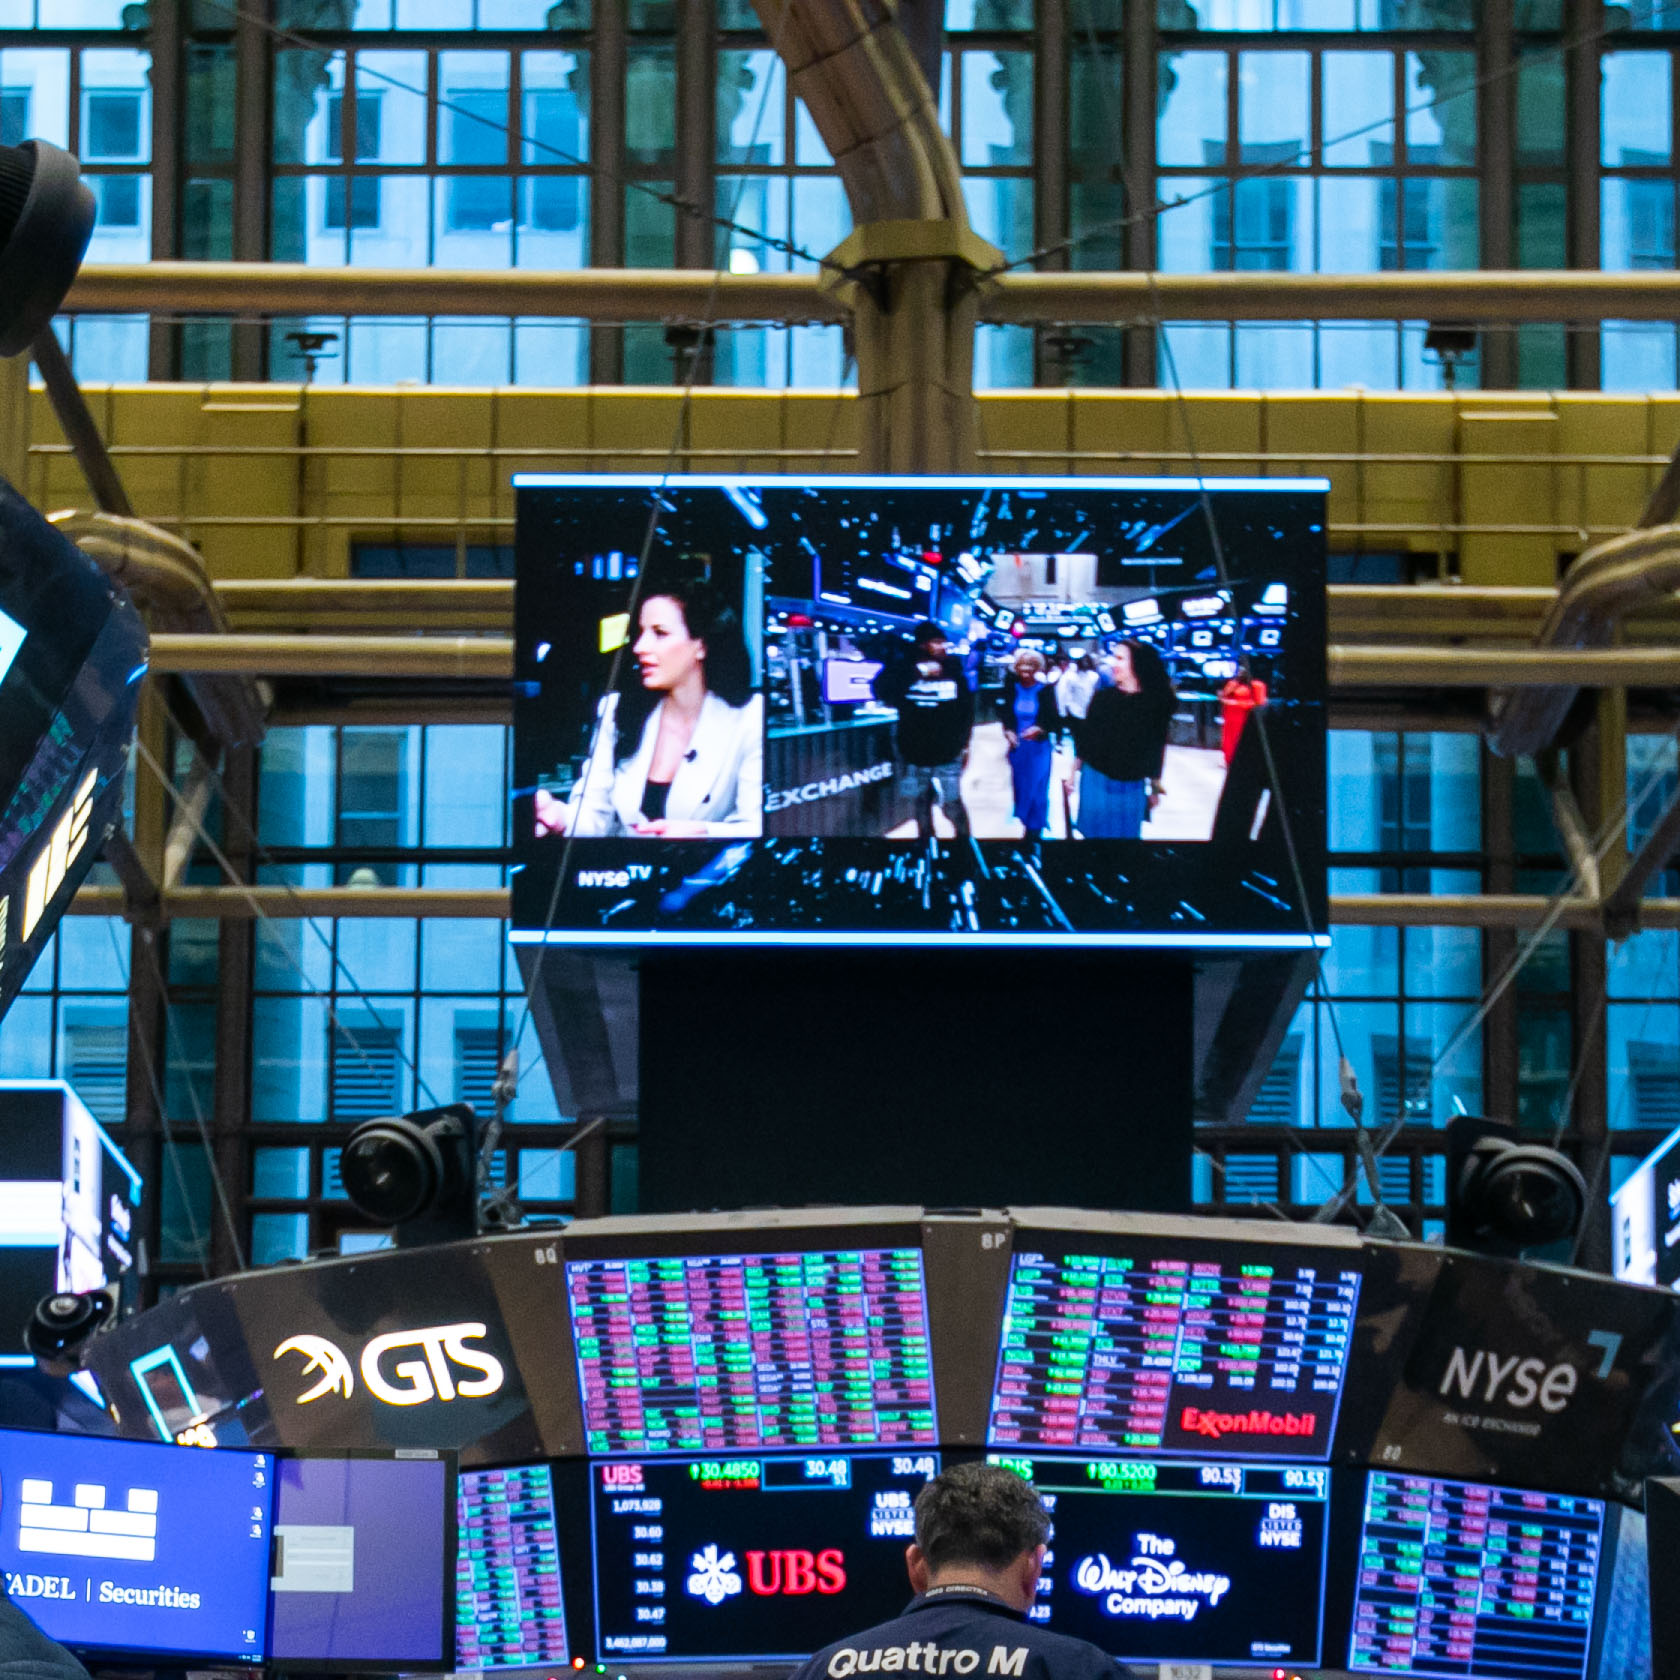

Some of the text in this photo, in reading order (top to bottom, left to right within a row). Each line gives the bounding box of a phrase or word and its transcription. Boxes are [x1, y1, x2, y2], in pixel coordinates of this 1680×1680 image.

[764, 761, 893, 812] EXCHANGE
[360, 1321, 505, 1407] GTS
[1180, 1406, 1317, 1438] ExxonMobil
[602, 1464, 644, 1485] UBS
[700, 1461, 761, 1481] 30.4850
[806, 1460, 848, 1478] 30.48
[892, 1456, 936, 1476] 30.48
[1097, 1463, 1158, 1481] 90.5200
[1200, 1466, 1242, 1485] 90.53
[1283, 1469, 1325, 1488] 90.53
[874, 1491, 910, 1509] UBS
[1268, 1502, 1297, 1520] DIS
[871, 1520, 916, 1537] NYSE
[1136, 1533, 1176, 1556] The
[1259, 1532, 1303, 1549] NYSE
[745, 1547, 848, 1597] UBS
[4, 1573, 202, 1612] ADEL Securities
[1106, 1593, 1200, 1621] Company
[827, 1641, 1030, 1680] Quattro M
